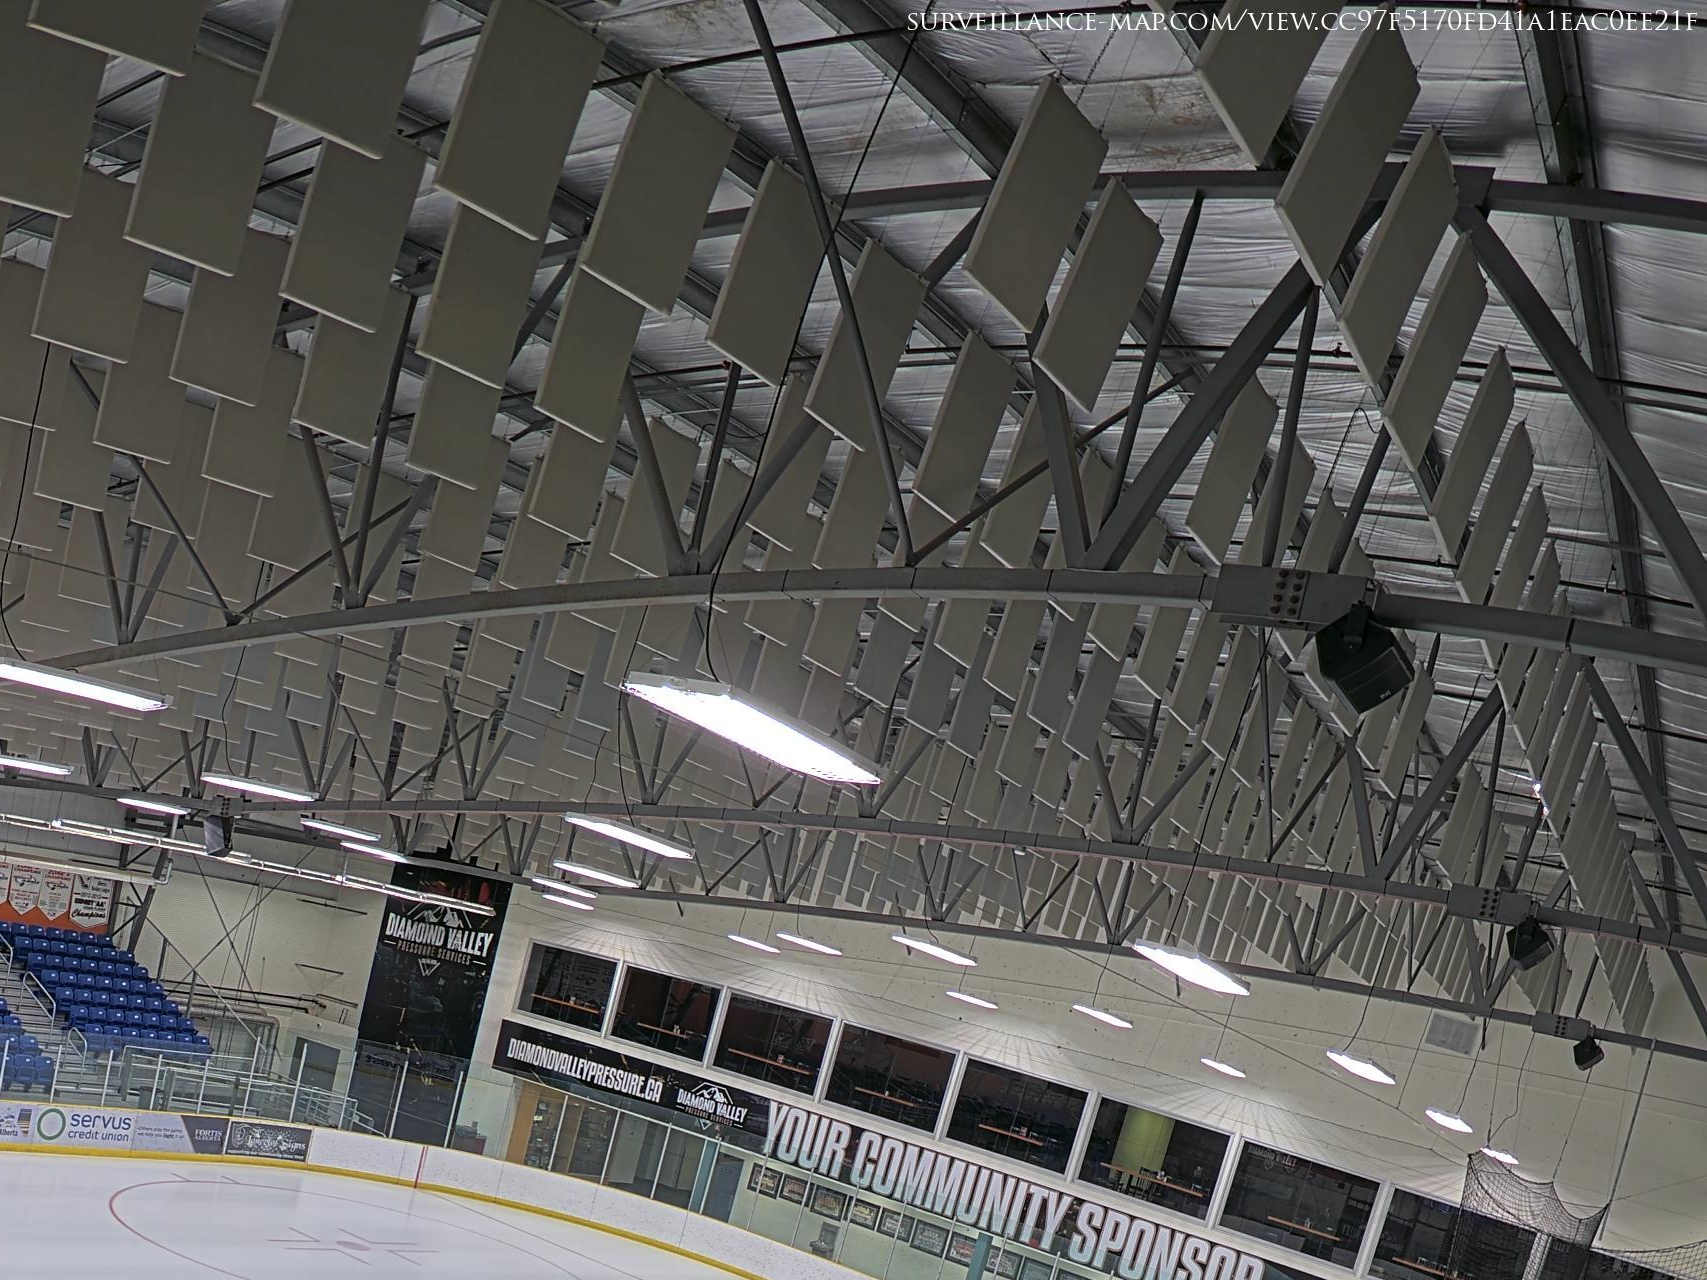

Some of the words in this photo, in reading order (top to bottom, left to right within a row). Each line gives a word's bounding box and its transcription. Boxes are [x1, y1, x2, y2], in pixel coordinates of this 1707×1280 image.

[71, 908, 106, 919] Champions
[446, 928, 494, 957] VALLEY
[437, 948, 471, 965] SERVICES
[507, 1037, 663, 1103] DIAMONDVALLEYPRESSURE.CA
[676, 1088, 716, 1114] DIAMOND
[716, 1103, 748, 1124] VALLEY
[70, 1113, 132, 1130] servus
[68, 1129, 100, 1140] credit
[101, 1131, 129, 1142] union
[765, 1099, 852, 1181] YOUR
[850, 1130, 1074, 1251] COMMUNITY
